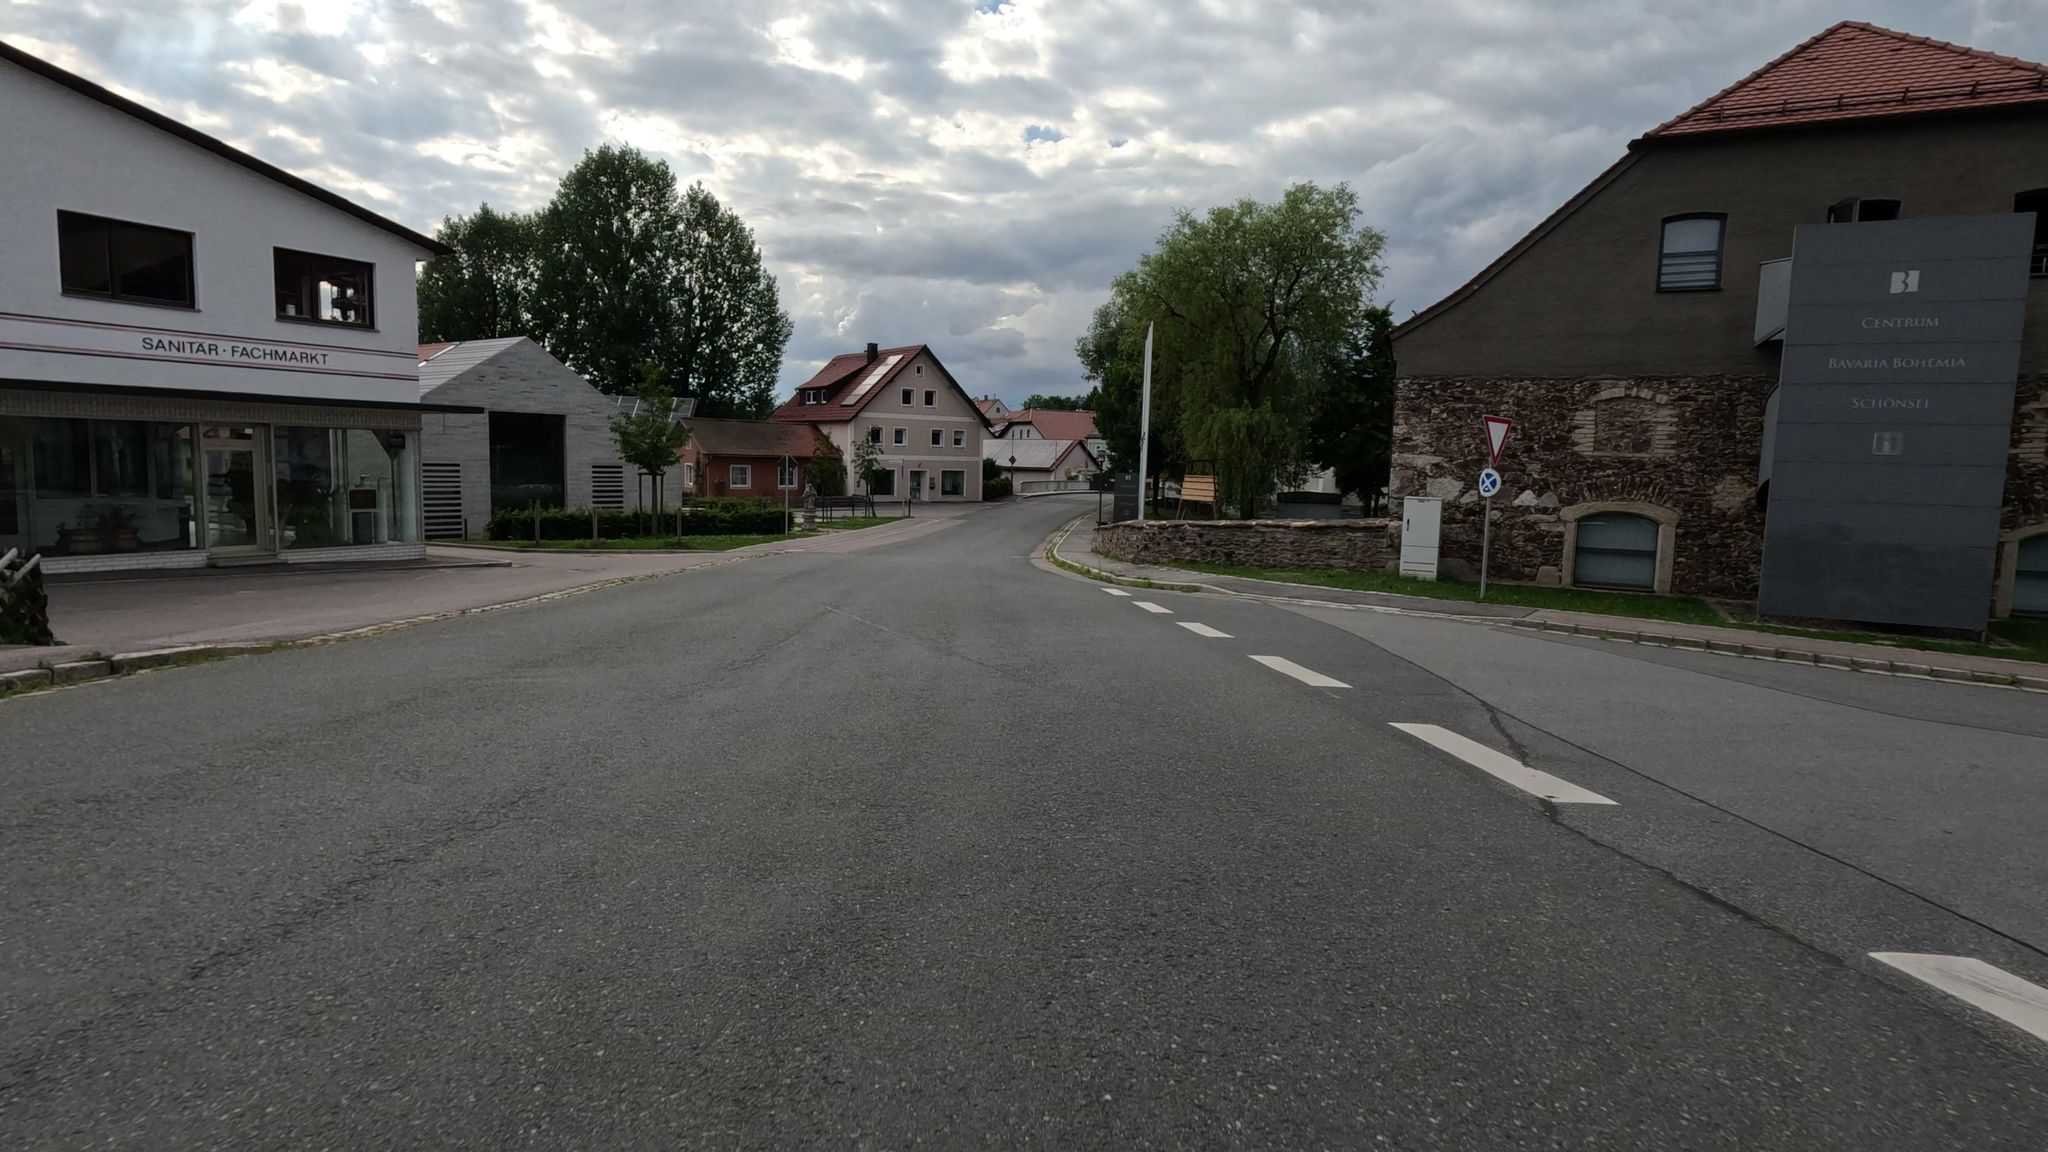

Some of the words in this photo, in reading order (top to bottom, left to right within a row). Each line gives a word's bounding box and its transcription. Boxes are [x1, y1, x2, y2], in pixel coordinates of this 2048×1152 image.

[1861, 317, 1939, 329] CENTRUM
[142, 337, 218, 356] SANITÄR
[231, 346, 329, 366] FACHMARKT
[1828, 357, 1888, 369] BAVARIA
[1893, 357, 1967, 369] BOHEMIA
